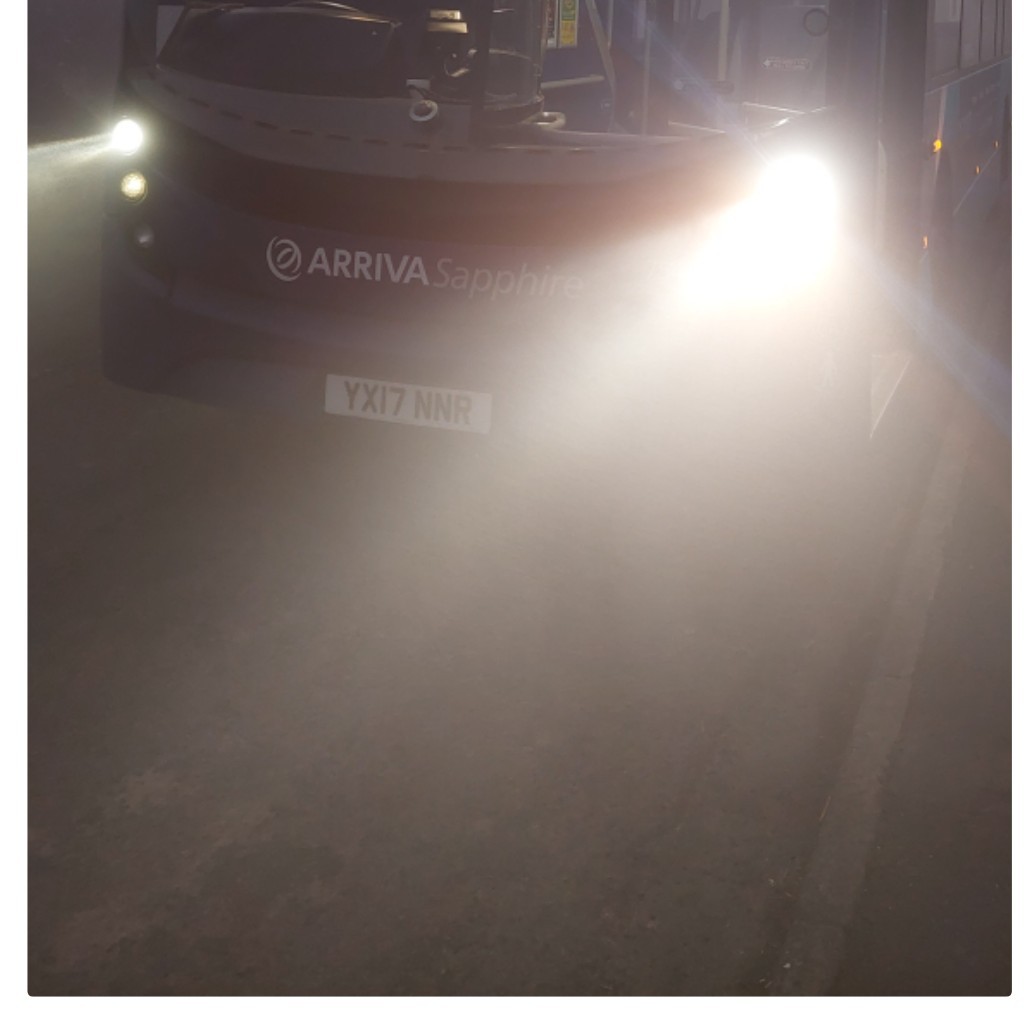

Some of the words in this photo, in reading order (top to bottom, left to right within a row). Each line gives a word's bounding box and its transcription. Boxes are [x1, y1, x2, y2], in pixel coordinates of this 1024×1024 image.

[307, 247, 430, 286] ARRIVA
[432, 258, 584, 301] Sapphire
[343, 380, 407, 417] YX17
[414, 389, 473, 425] NNR
